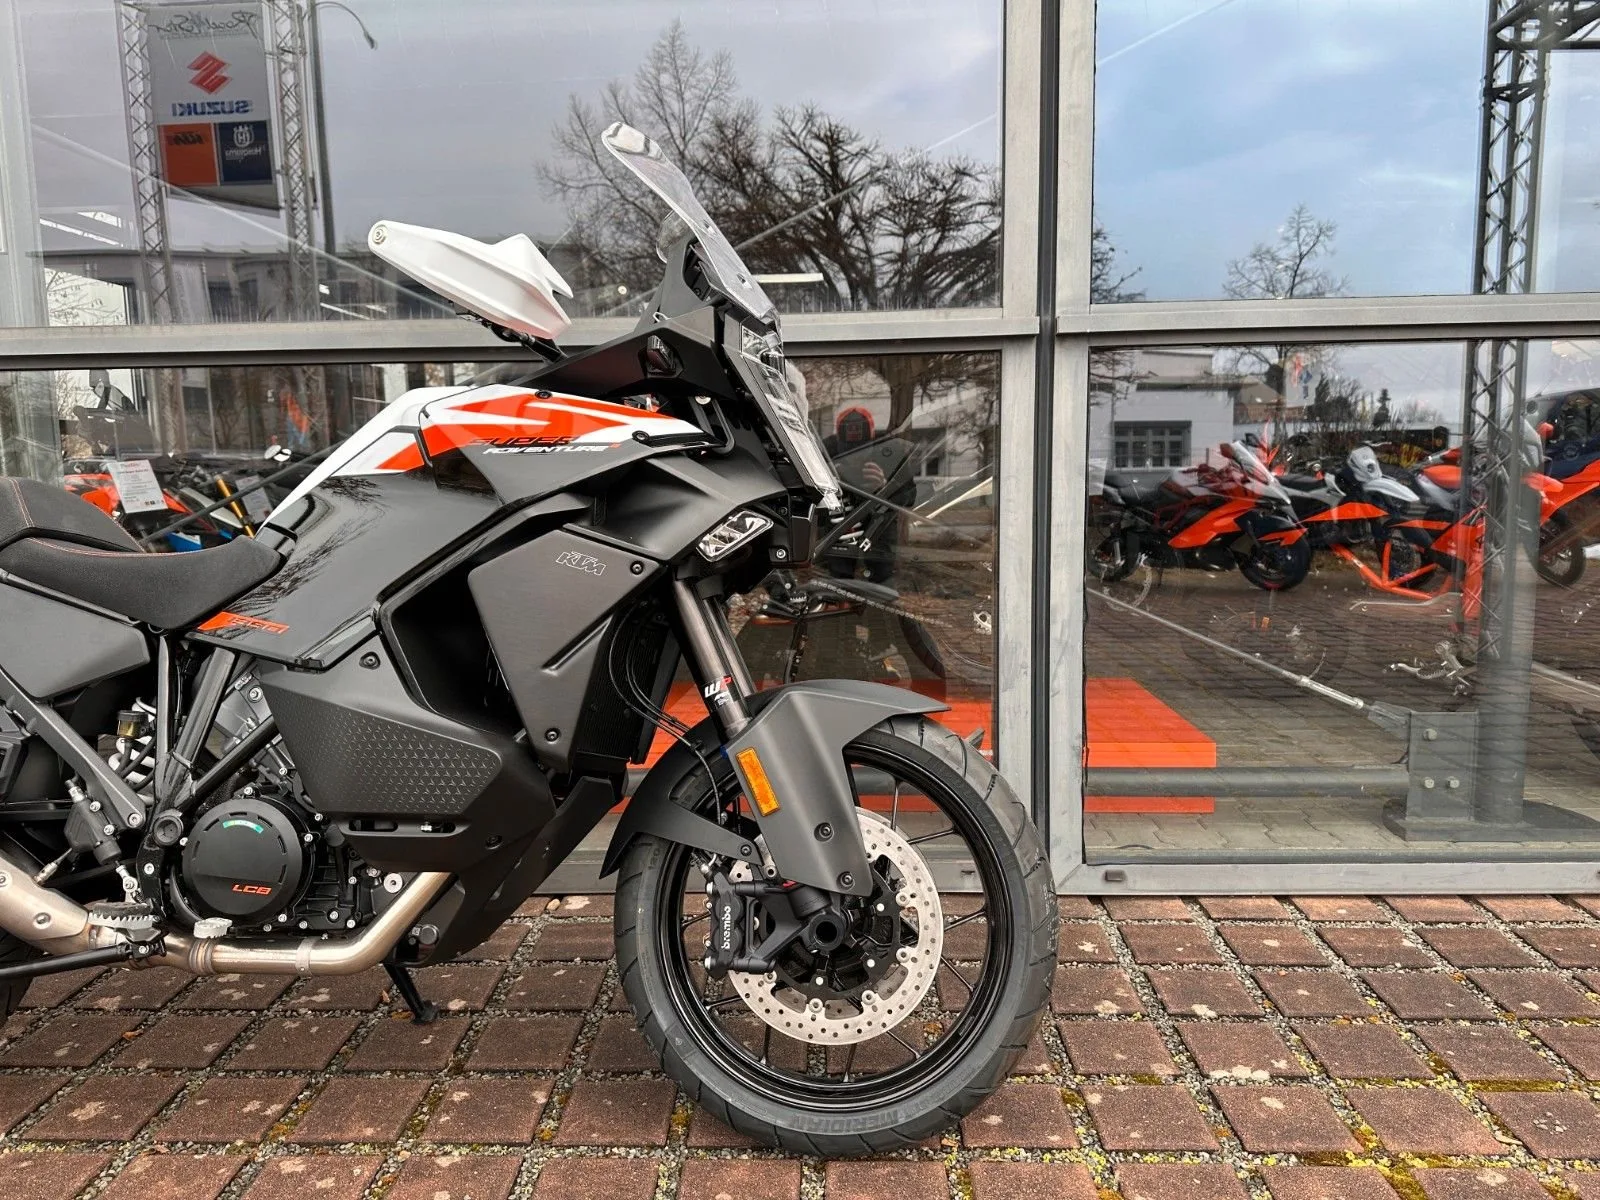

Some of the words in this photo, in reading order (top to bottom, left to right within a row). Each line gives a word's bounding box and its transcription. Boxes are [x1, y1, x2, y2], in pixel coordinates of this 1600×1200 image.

[482, 444, 610, 456] ADVENTURE
[555, 551, 607, 576] KTM
[232, 884, 273, 896] LC8
[721, 905, 732, 950] brembo
